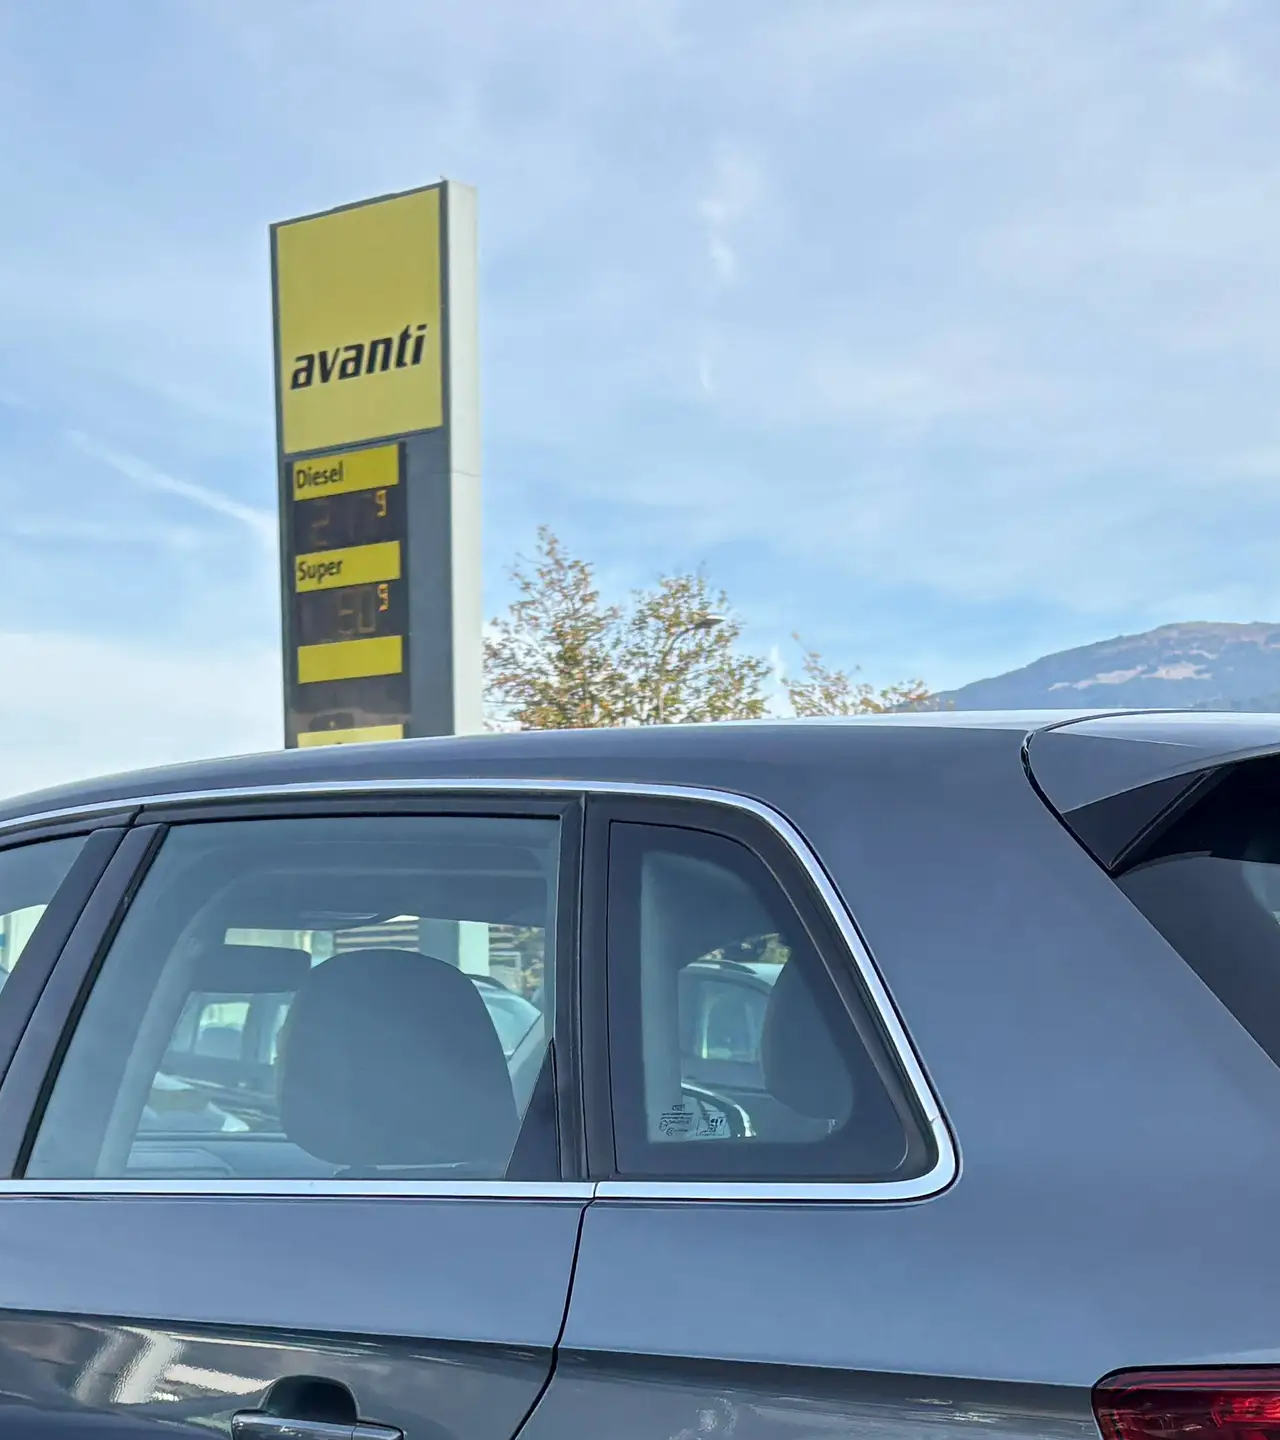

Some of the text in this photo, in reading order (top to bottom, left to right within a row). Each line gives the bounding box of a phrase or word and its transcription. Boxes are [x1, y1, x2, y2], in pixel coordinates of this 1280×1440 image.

[290, 323, 427, 390] avanti
[296, 460, 344, 489] Diesel
[298, 560, 343, 584] Super
